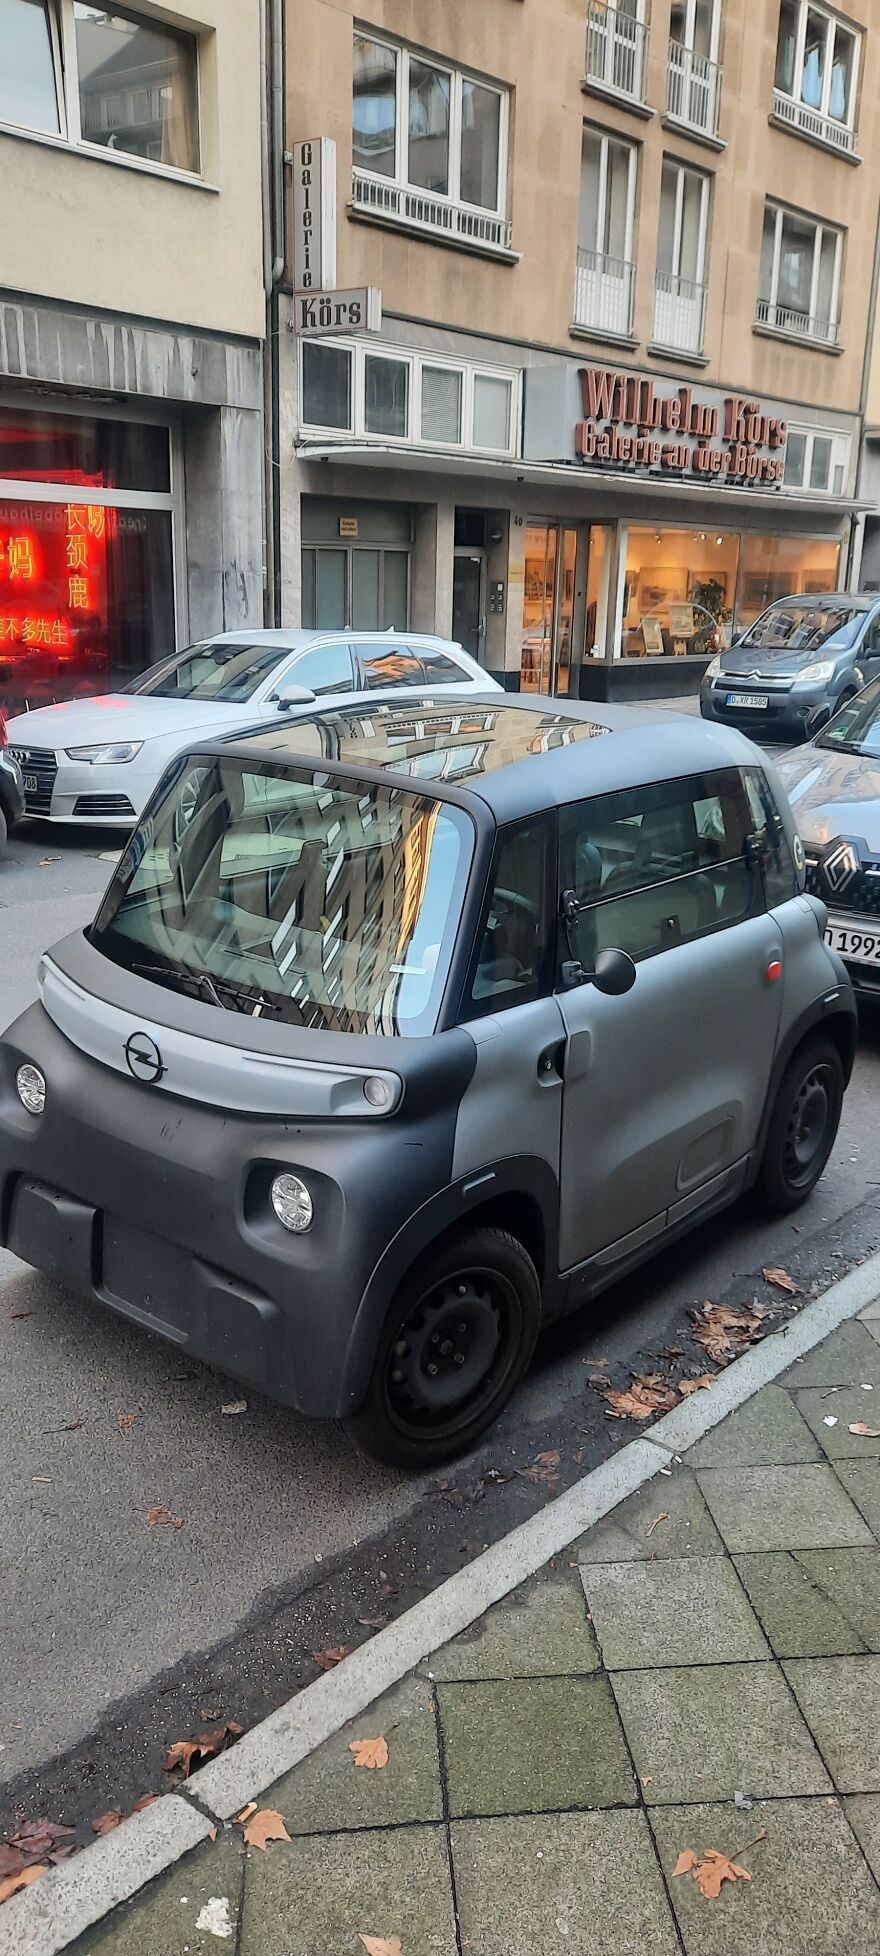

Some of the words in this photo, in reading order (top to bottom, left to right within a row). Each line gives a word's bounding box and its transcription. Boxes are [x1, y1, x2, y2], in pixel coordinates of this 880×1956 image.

[301, 143, 313, 288] Galerie
[301, 297, 361, 329] Körs
[579, 368, 719, 437] Wilhelm
[723, 397, 787, 449] Körs
[576, 421, 662, 465] Galerie
[662, 442, 691, 470] an
[693, 440, 731, 474] der
[728, 444, 784, 481] Börse
[513, 514, 523, 527] 40
[0, 536, 34, 579] 妈
[64, 503, 89, 608] 长颈鹿
[750, 697, 767, 705] 1585
